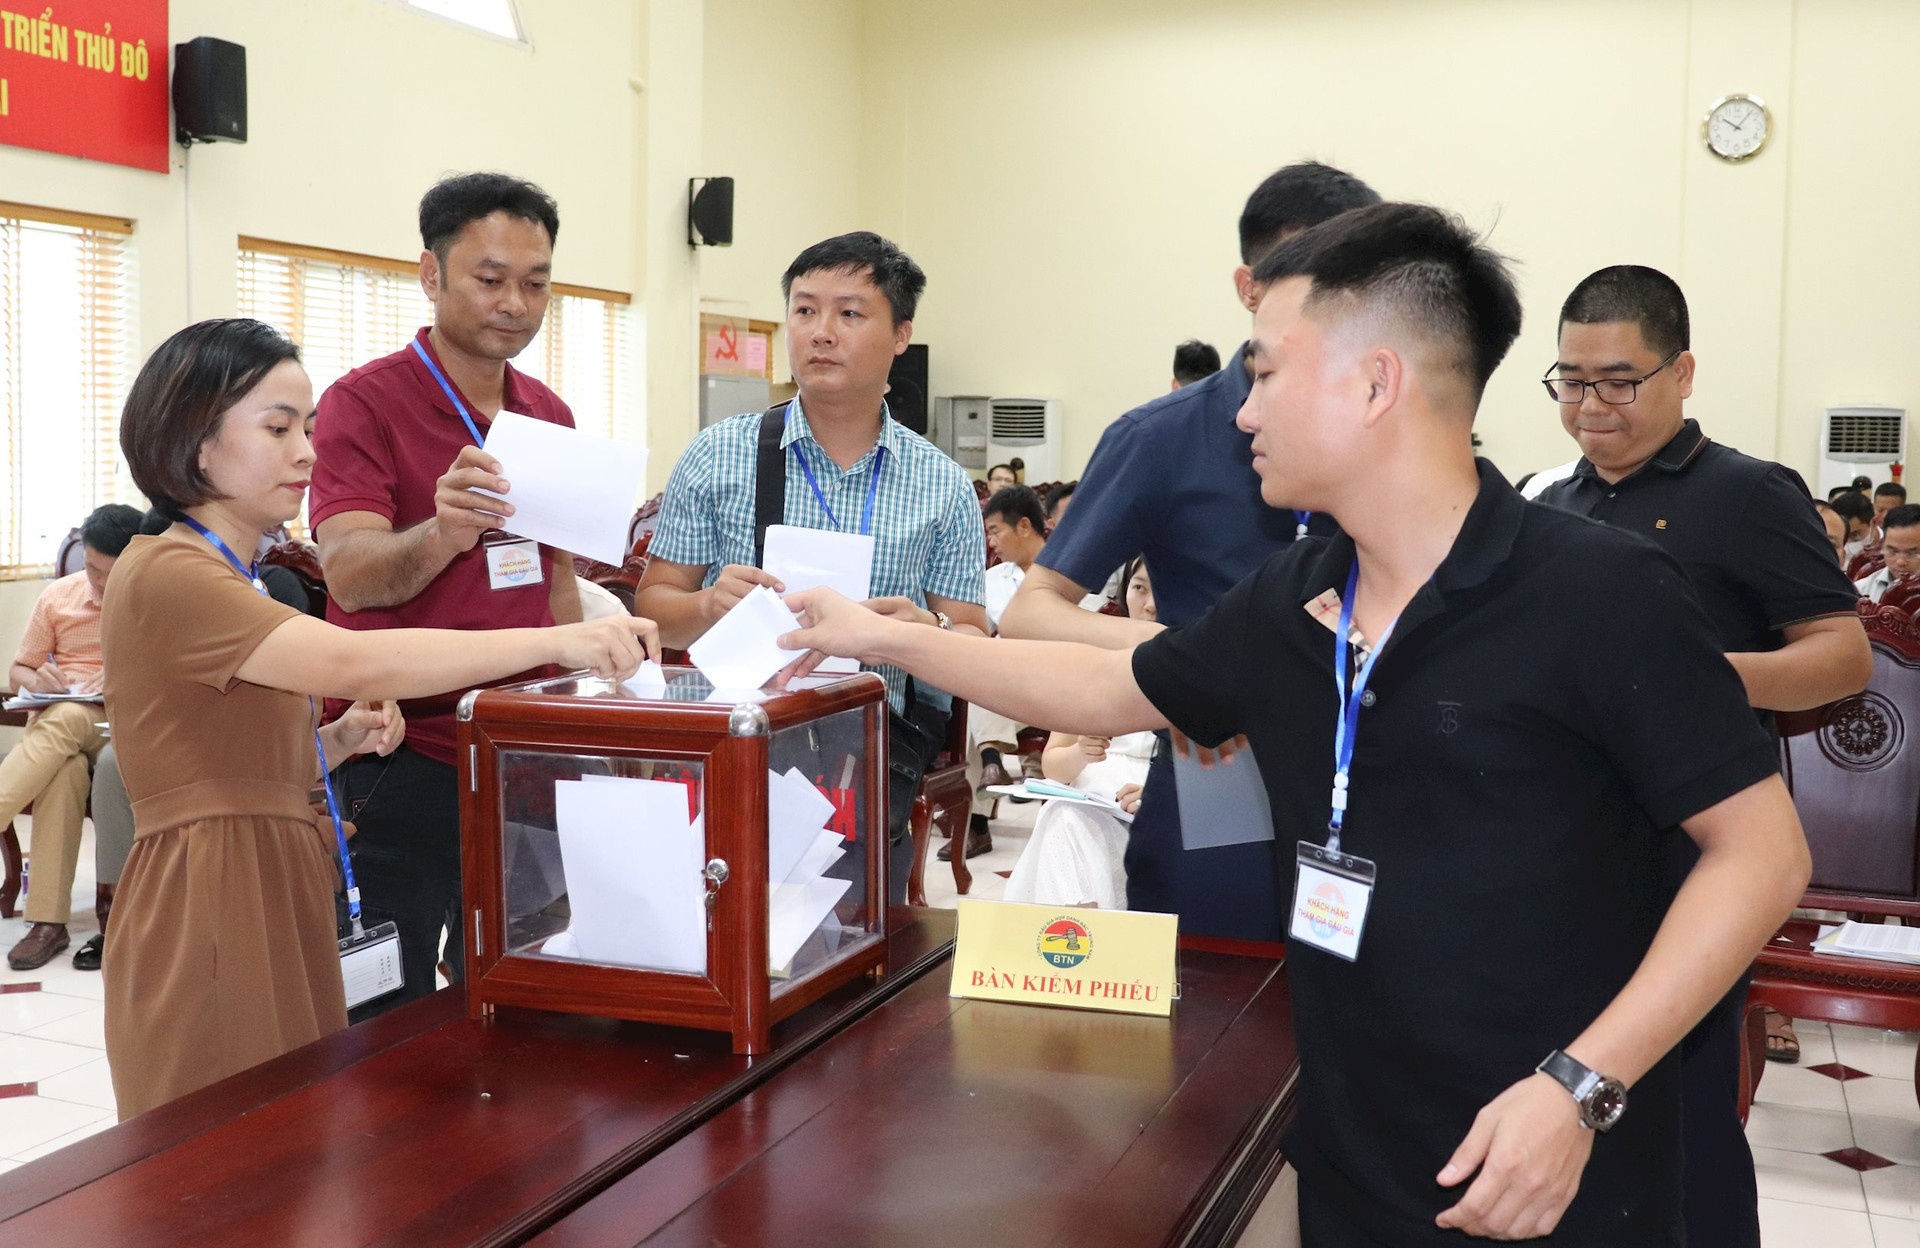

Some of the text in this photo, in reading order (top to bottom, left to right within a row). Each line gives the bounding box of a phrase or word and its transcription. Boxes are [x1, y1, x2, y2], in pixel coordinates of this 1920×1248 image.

[1, 7, 149, 81] TRIỂN THỦ ĐÔ
[1053, 954, 1075, 964] BTN
[971, 967, 1016, 989] BÀN
[1089, 979, 1160, 1002] PHIẾU
